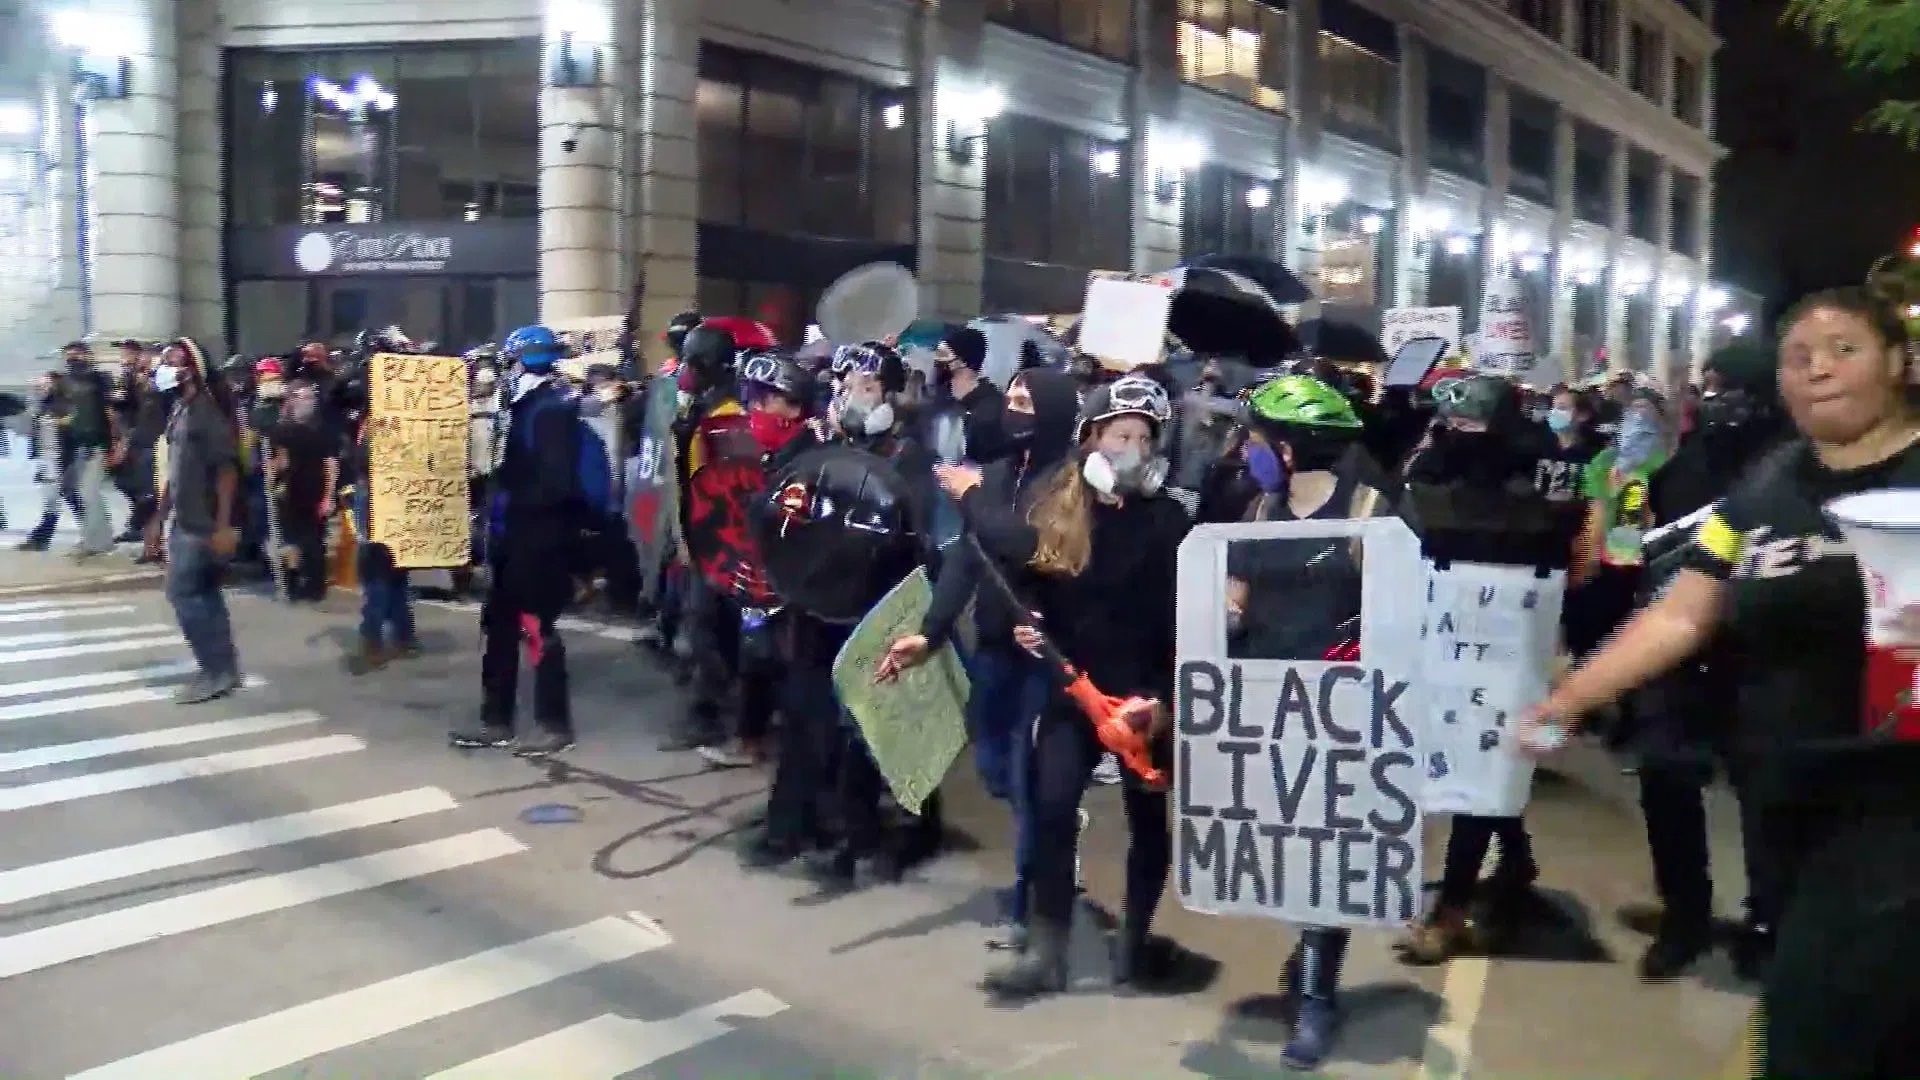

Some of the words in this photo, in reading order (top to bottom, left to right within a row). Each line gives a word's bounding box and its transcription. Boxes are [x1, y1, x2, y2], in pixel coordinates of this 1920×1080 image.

[383, 356, 465, 388] BLACK
[383, 386, 465, 412] LIVES
[379, 476, 467, 498] JUSTICE
[404, 498, 445, 516] FOR
[1179, 660, 1414, 749] BLACK
[1180, 741, 1416, 835] LIVES
[1180, 818, 1416, 921] MATTER
